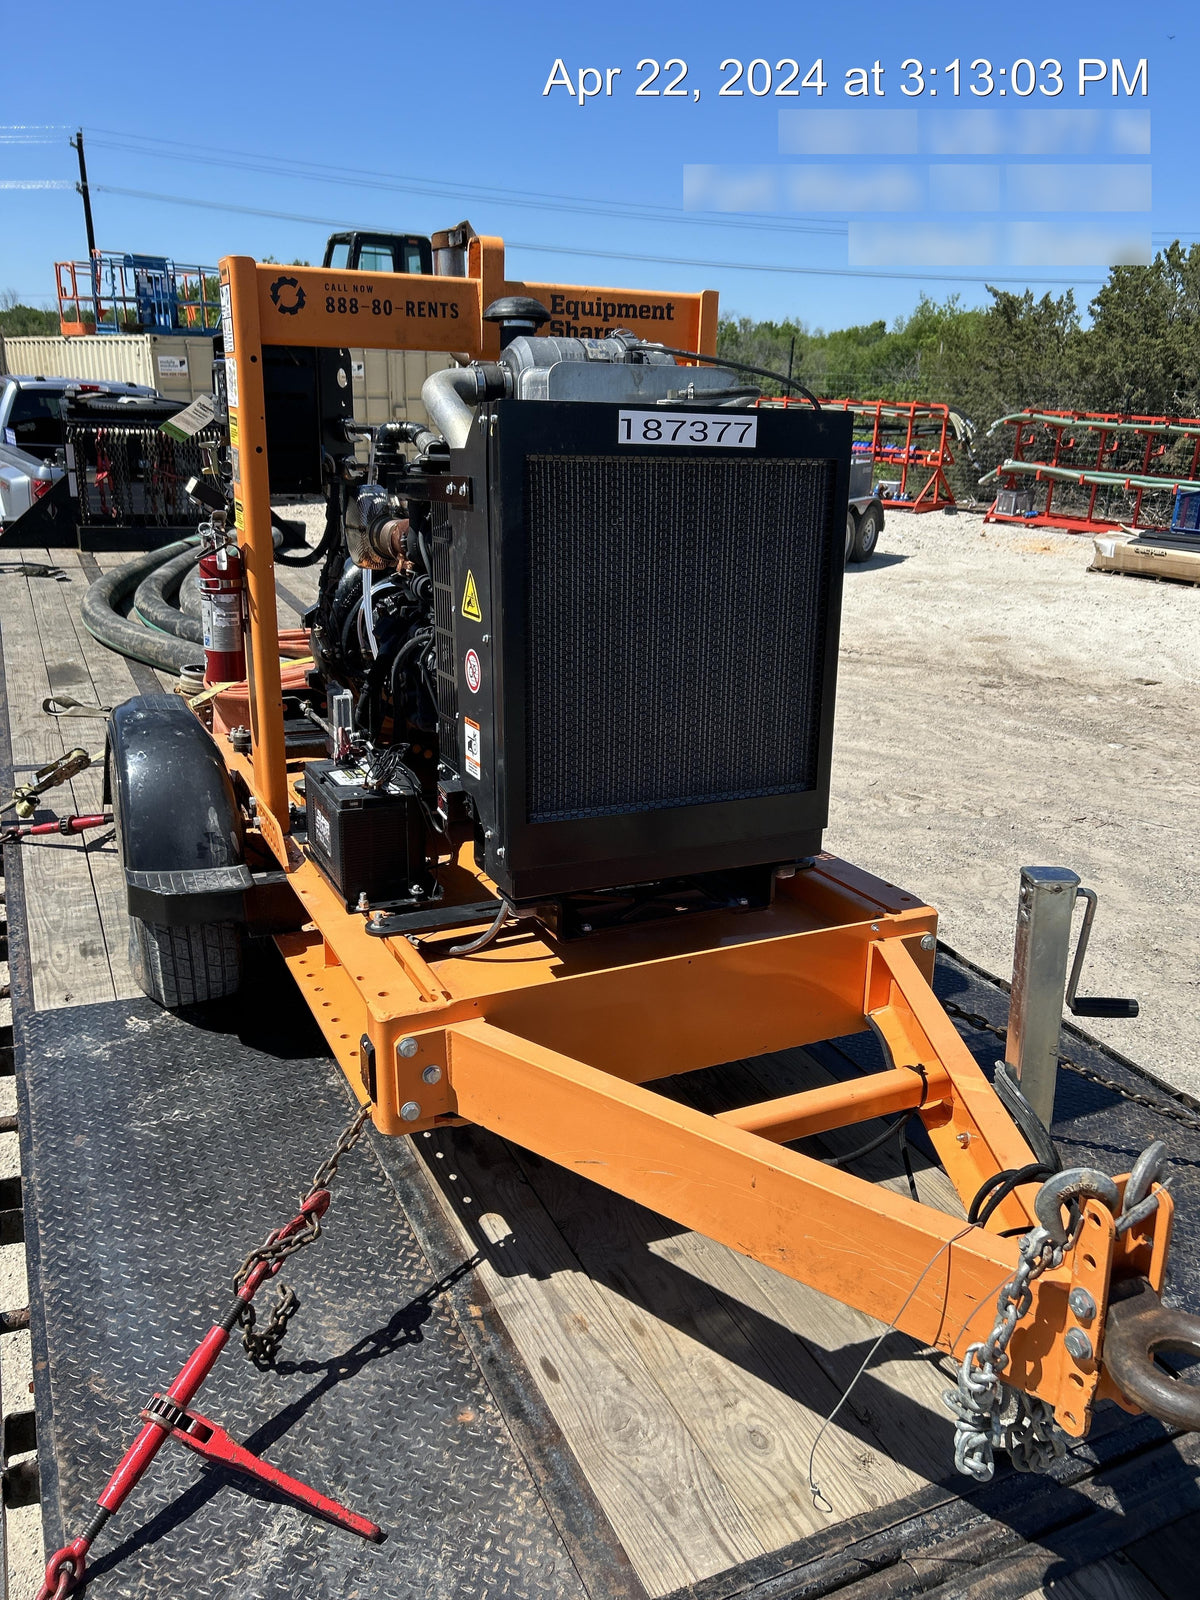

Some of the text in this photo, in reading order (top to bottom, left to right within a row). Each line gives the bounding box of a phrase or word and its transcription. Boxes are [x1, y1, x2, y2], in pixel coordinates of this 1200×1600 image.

[324, 283, 374, 294] CALL NOW
[325, 296, 460, 319] 888-80-RENTS
[550, 294, 675, 322] Equipment
[620, 418, 753, 444] 187377
